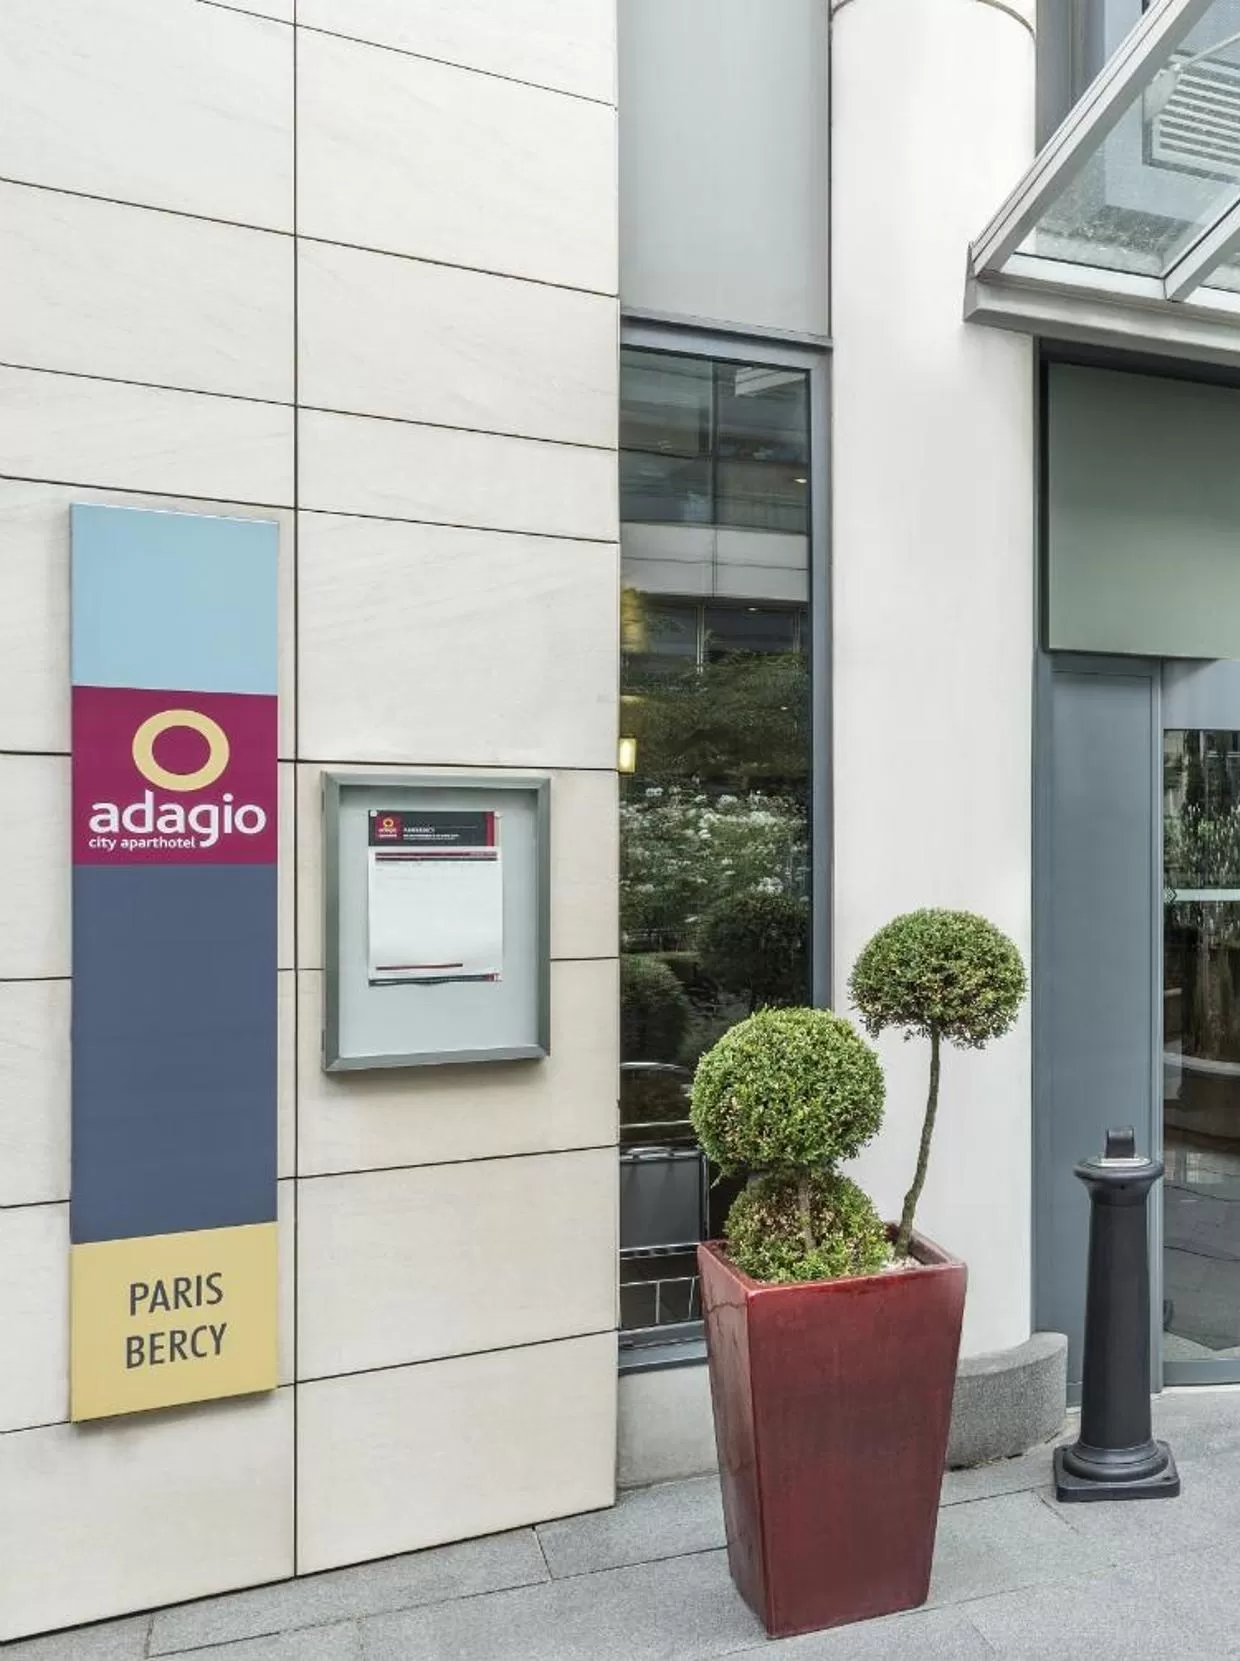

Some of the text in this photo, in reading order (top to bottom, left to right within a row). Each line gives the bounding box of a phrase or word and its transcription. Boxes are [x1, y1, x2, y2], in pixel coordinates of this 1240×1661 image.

[88, 789, 267, 848] adagio
[88, 835, 196, 851] city aparthotel
[129, 1271, 224, 1317] PARIS
[125, 1322, 227, 1370] BERCY
